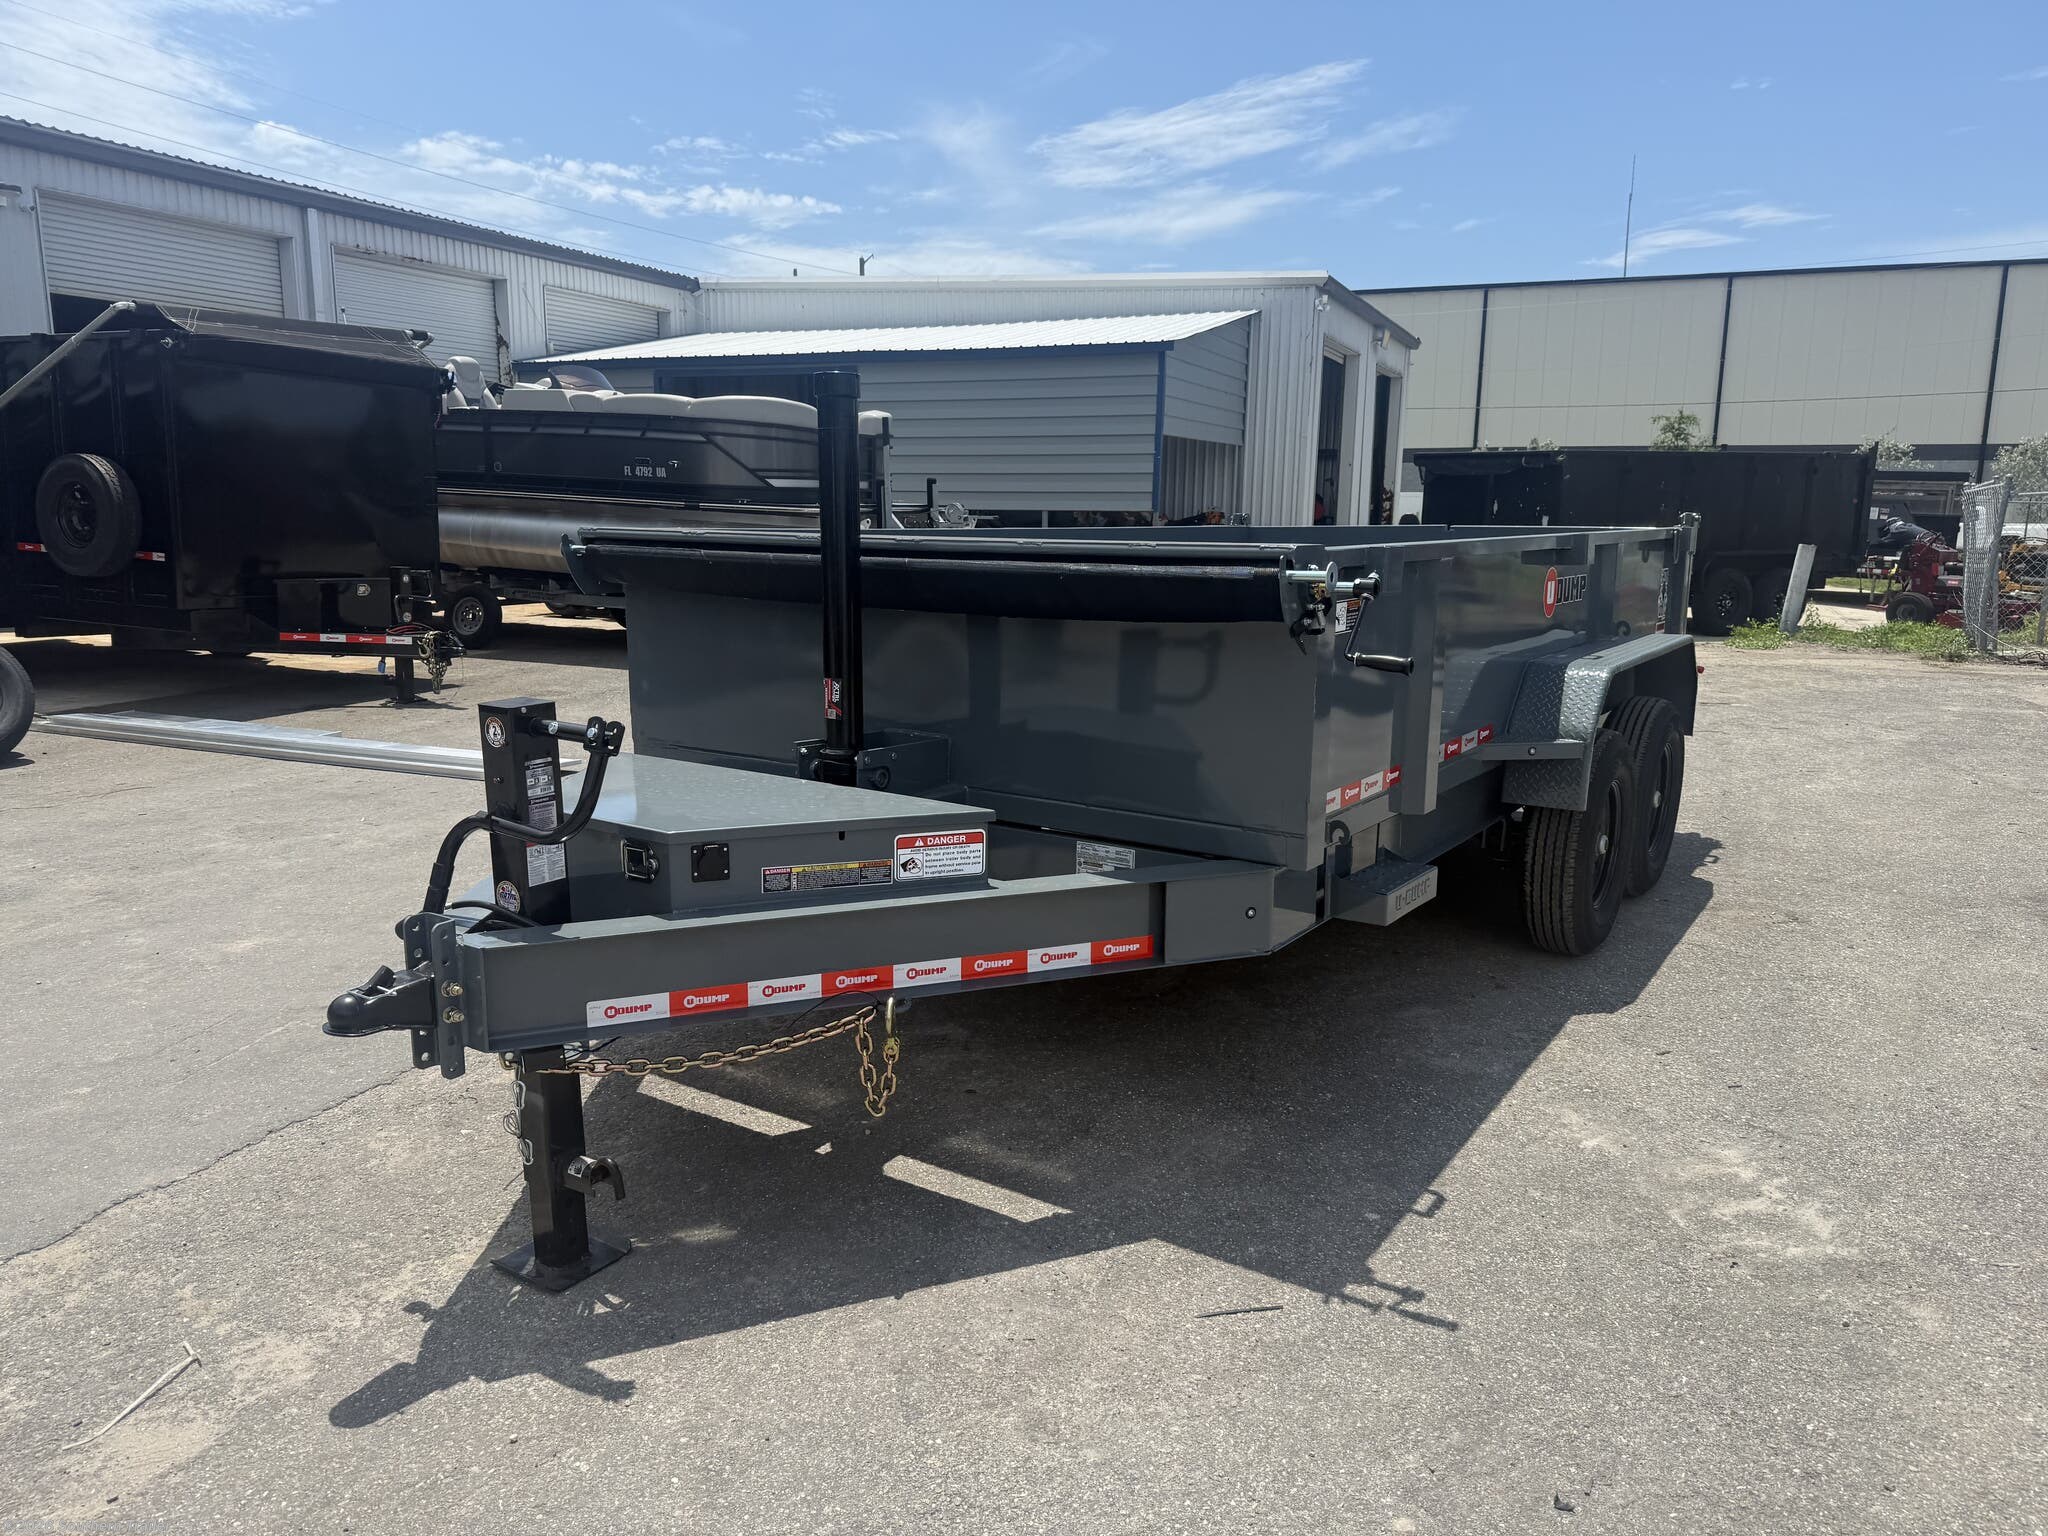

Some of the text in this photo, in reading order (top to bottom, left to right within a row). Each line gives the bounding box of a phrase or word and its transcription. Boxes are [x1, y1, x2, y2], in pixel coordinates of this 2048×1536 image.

[624, 465, 632, 476] FL
[635, 466, 653, 477] 4792
[927, 835, 966, 845] DANGER
